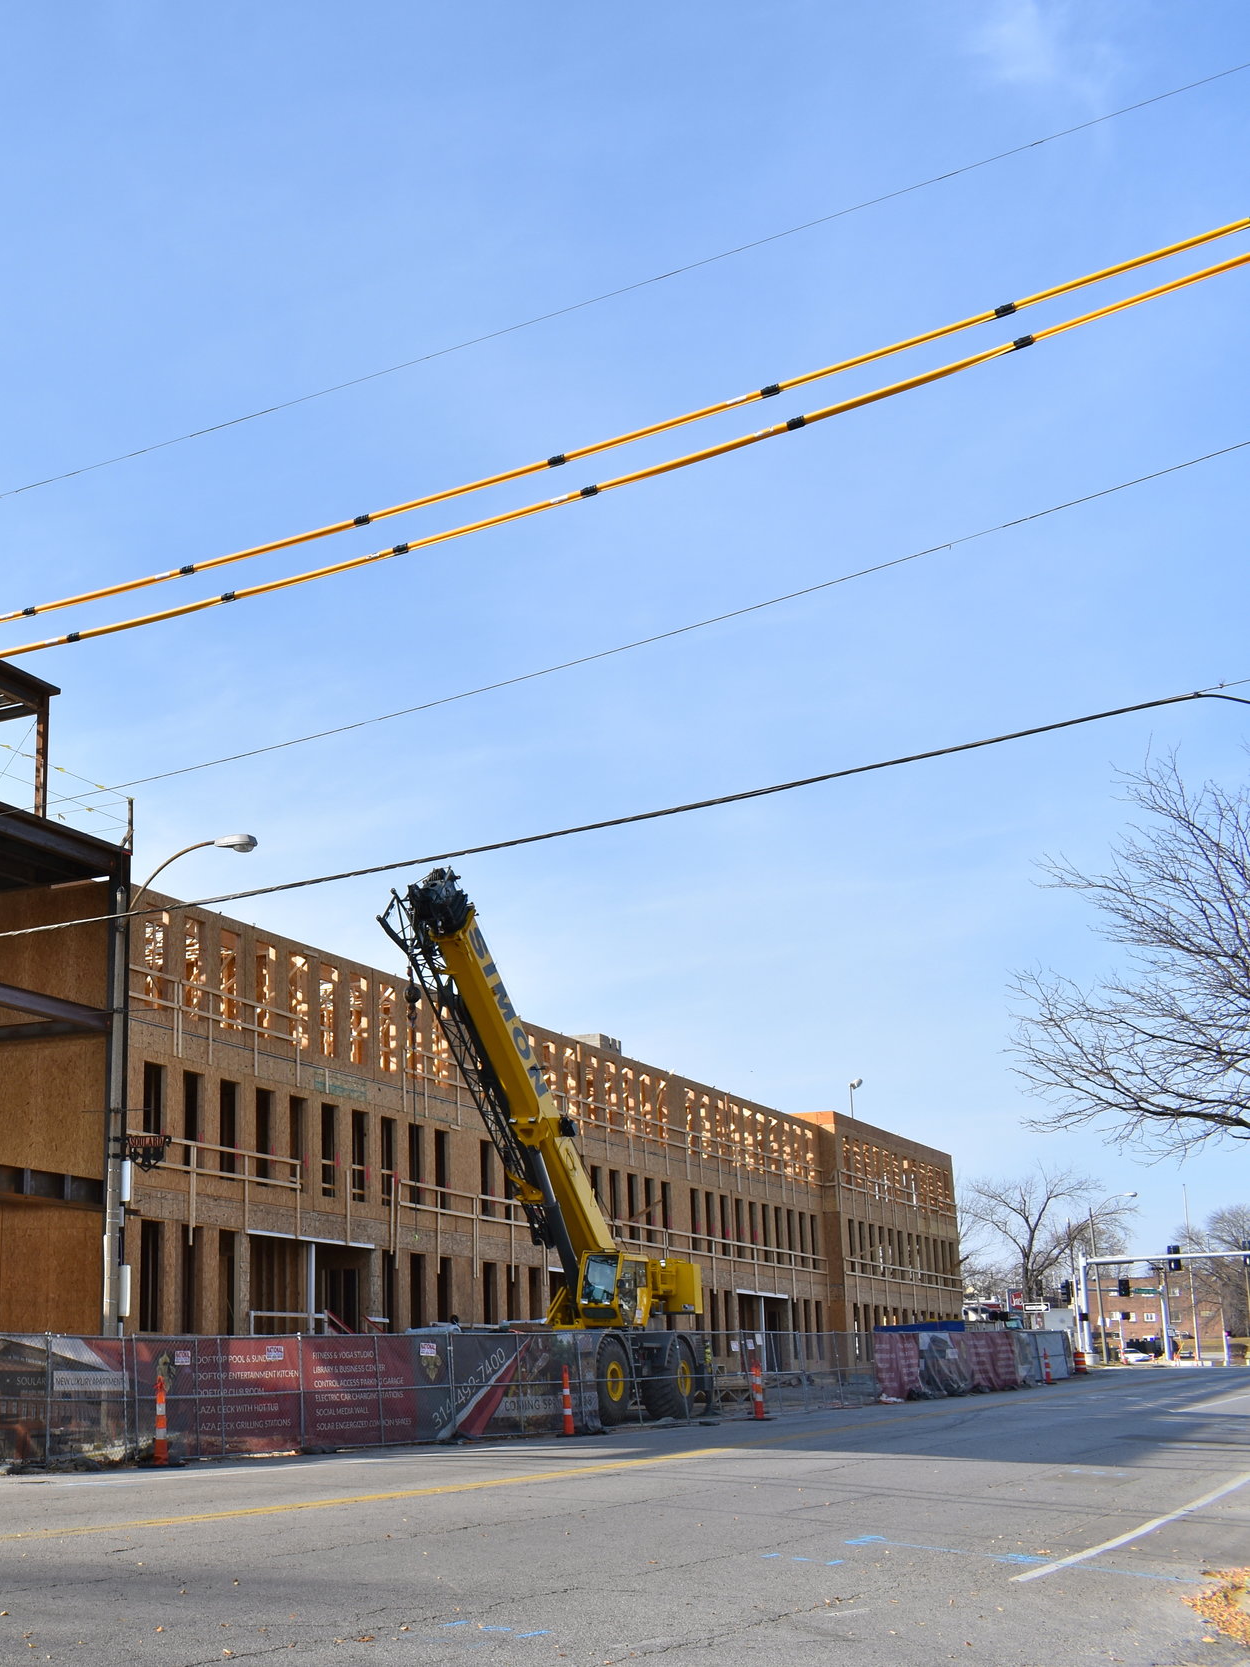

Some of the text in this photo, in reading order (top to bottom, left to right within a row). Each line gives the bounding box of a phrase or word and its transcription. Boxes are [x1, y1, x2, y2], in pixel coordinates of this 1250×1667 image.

[468, 926, 549, 1098] SIMON
[129, 1136, 165, 1147] SOULARD
[193, 1355, 228, 1364] OOFTOP
[228, 1354, 246, 1363] POOL
[354, 1350, 375, 1359] STUDIO
[340, 1364, 364, 1373] BUSINESS
[228, 1370, 277, 1380] ENTERTAINMENT
[277, 1369, 299, 1379] KITCHEN
[16, 1376, 47, 1386] SOULAR
[91, 1376, 124, 1387] APARTMENT
[314, 1379, 339, 1388] CONTROL
[340, 1378, 359, 1387] ACCESS
[431, 1347, 506, 1430] 314-499-7400
[315, 1393, 340, 1402] ELECTRIC
[504, 1398, 540, 1412] COMING
[193, 1422, 216, 1432] LAZA
[236, 1420, 264, 1430] GRILLING
[368, 1418, 395, 1428] COMON
